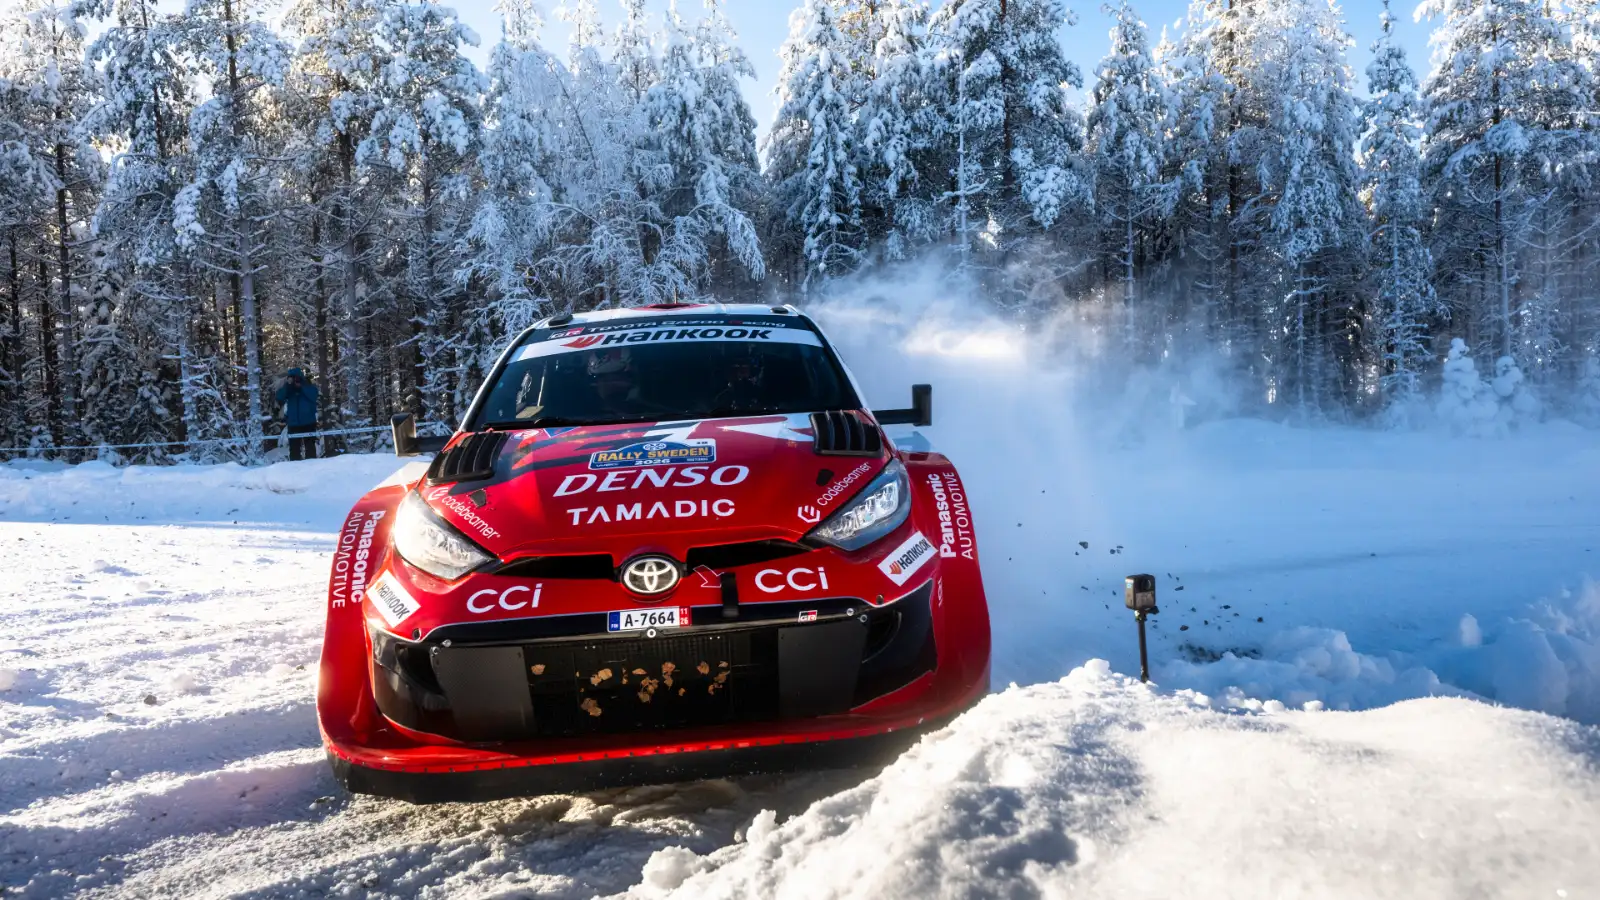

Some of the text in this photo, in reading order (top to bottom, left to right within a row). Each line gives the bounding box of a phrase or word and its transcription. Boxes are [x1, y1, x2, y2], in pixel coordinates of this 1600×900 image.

[588, 321, 656, 333] TOYOTA
[727, 319, 786, 328] Racing
[597, 447, 708, 462] RALLY SWEDEN
[634, 458, 670, 466] 2026
[553, 465, 750, 497] DENSO
[817, 462, 872, 506] codebeamer
[441, 496, 499, 539] codebeamer
[567, 499, 736, 526] TAMADIC
[927, 473, 957, 558] Panasonic
[943, 471, 974, 560] AUTOMOTIVE
[332, 511, 364, 609] AUTOMOTIVE
[351, 510, 387, 603] Panasonic
[624, 611, 675, 627] A-7664
[680, 617, 689, 625] 26
